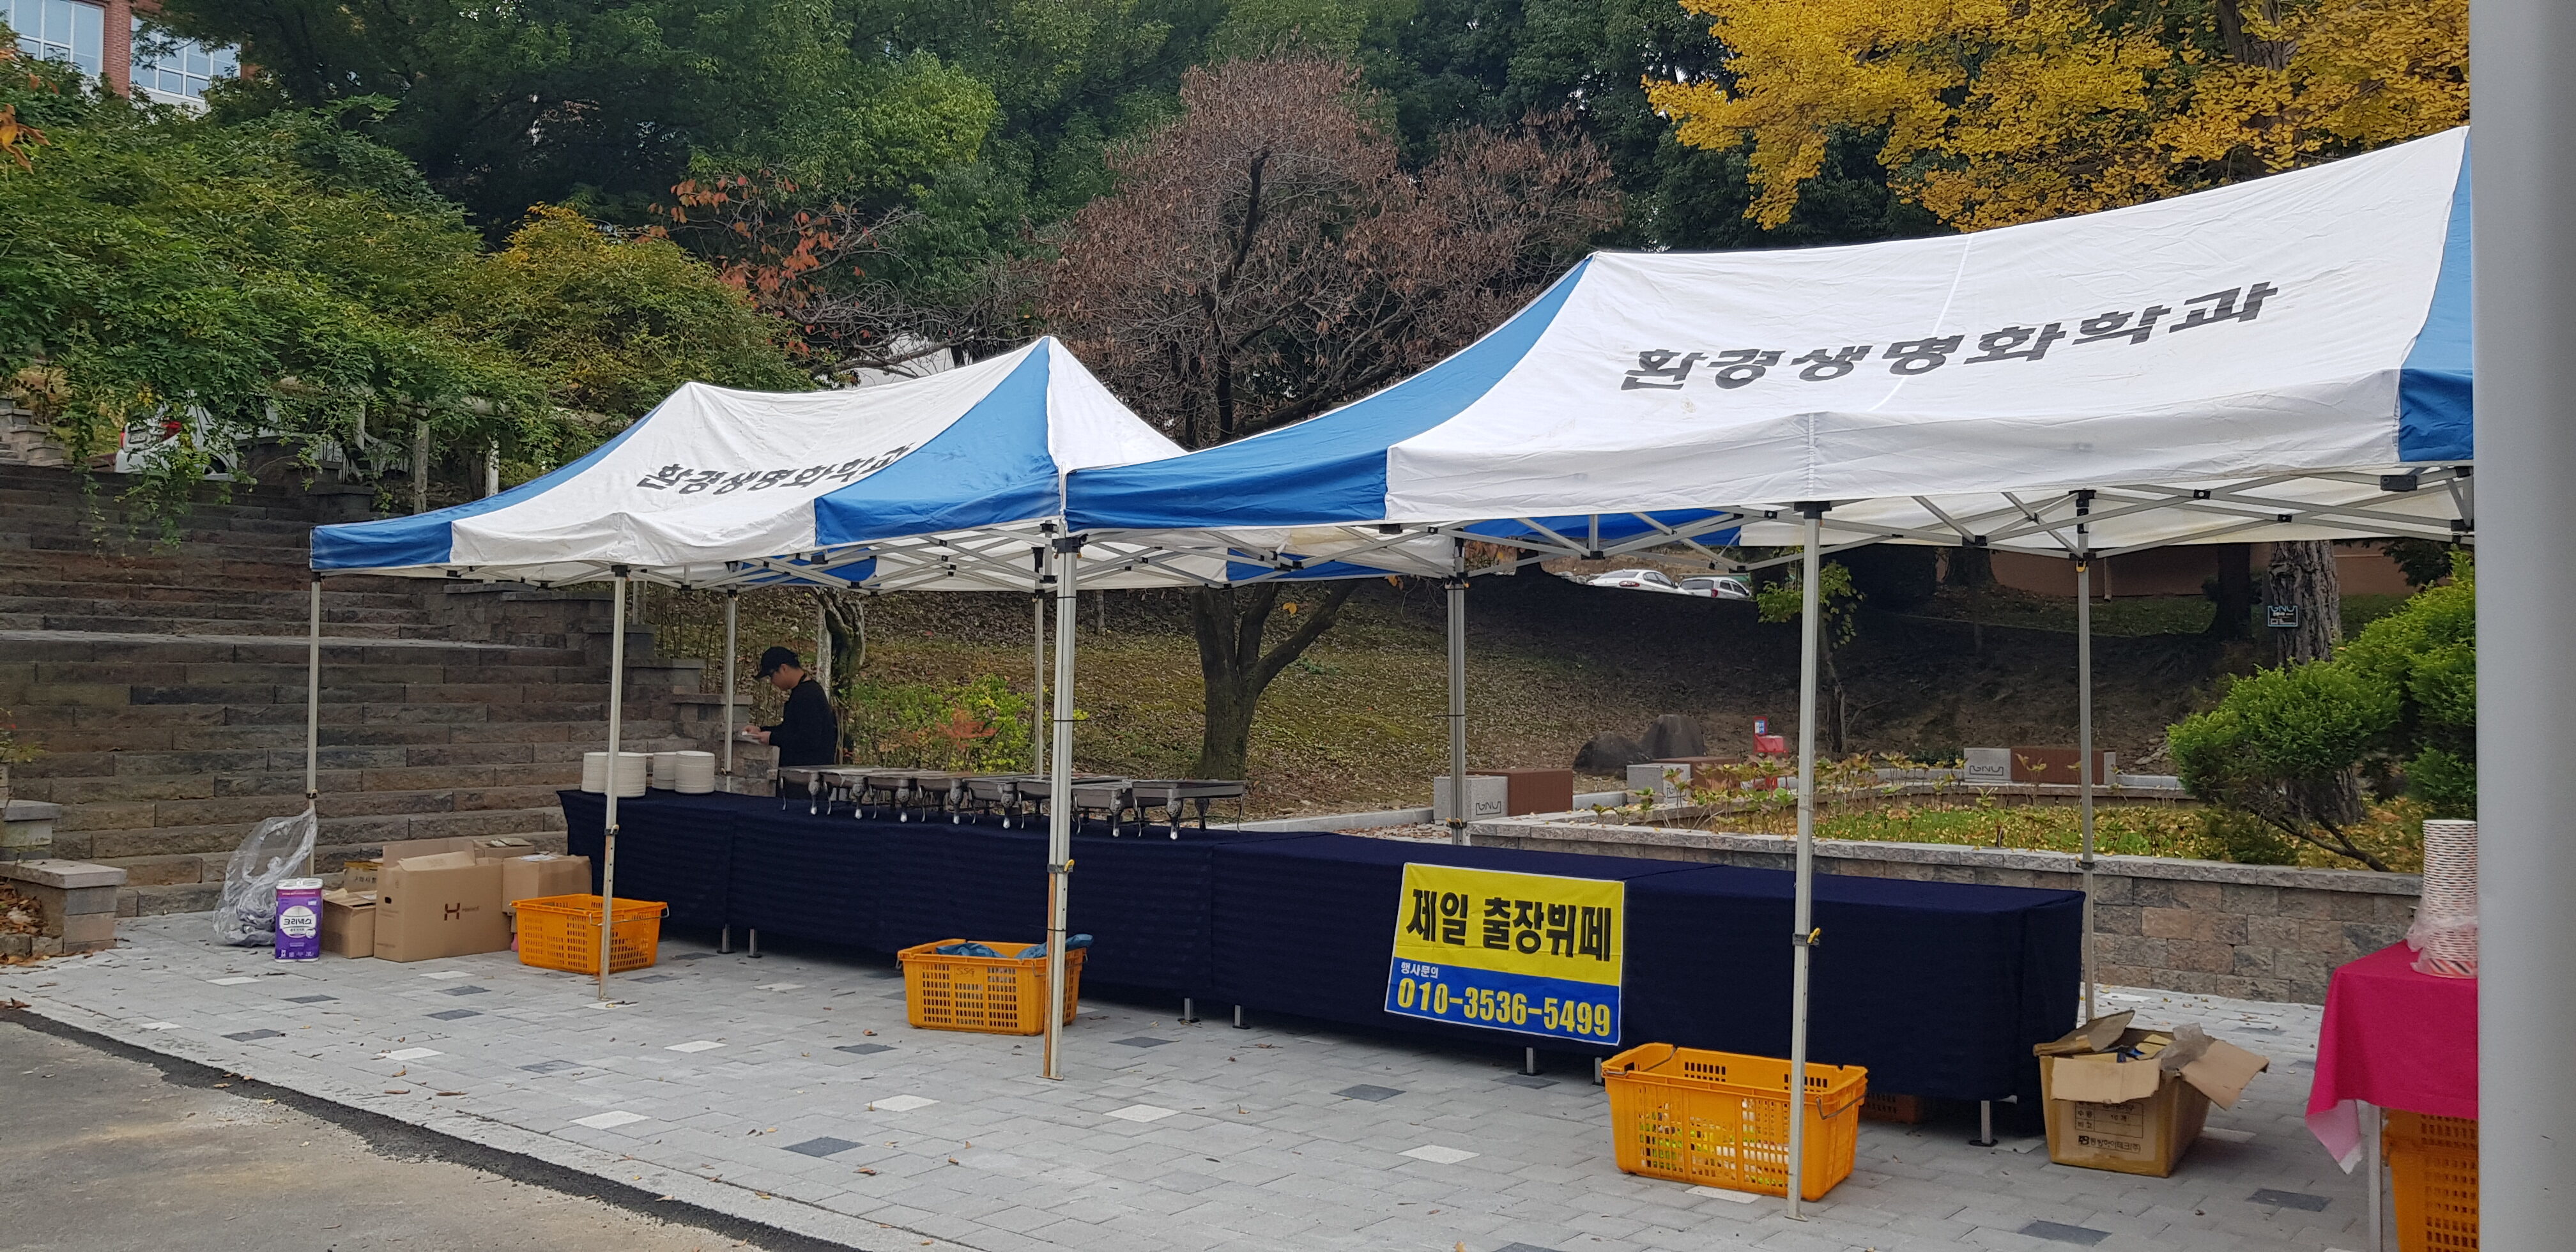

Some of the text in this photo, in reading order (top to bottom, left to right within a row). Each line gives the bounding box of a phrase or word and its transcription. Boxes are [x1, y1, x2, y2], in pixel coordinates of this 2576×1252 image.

[1620, 281, 2279, 390] 환경생명화학과
[636, 441, 915, 495] 환경생명화학과
[1476, 801, 1501, 811] GNU
[1406, 889, 1612, 962] 제일 출장뷔페
[1400, 962, 1439, 979] 행사문의
[1397, 978, 1611, 1037] 010-3536-5499
